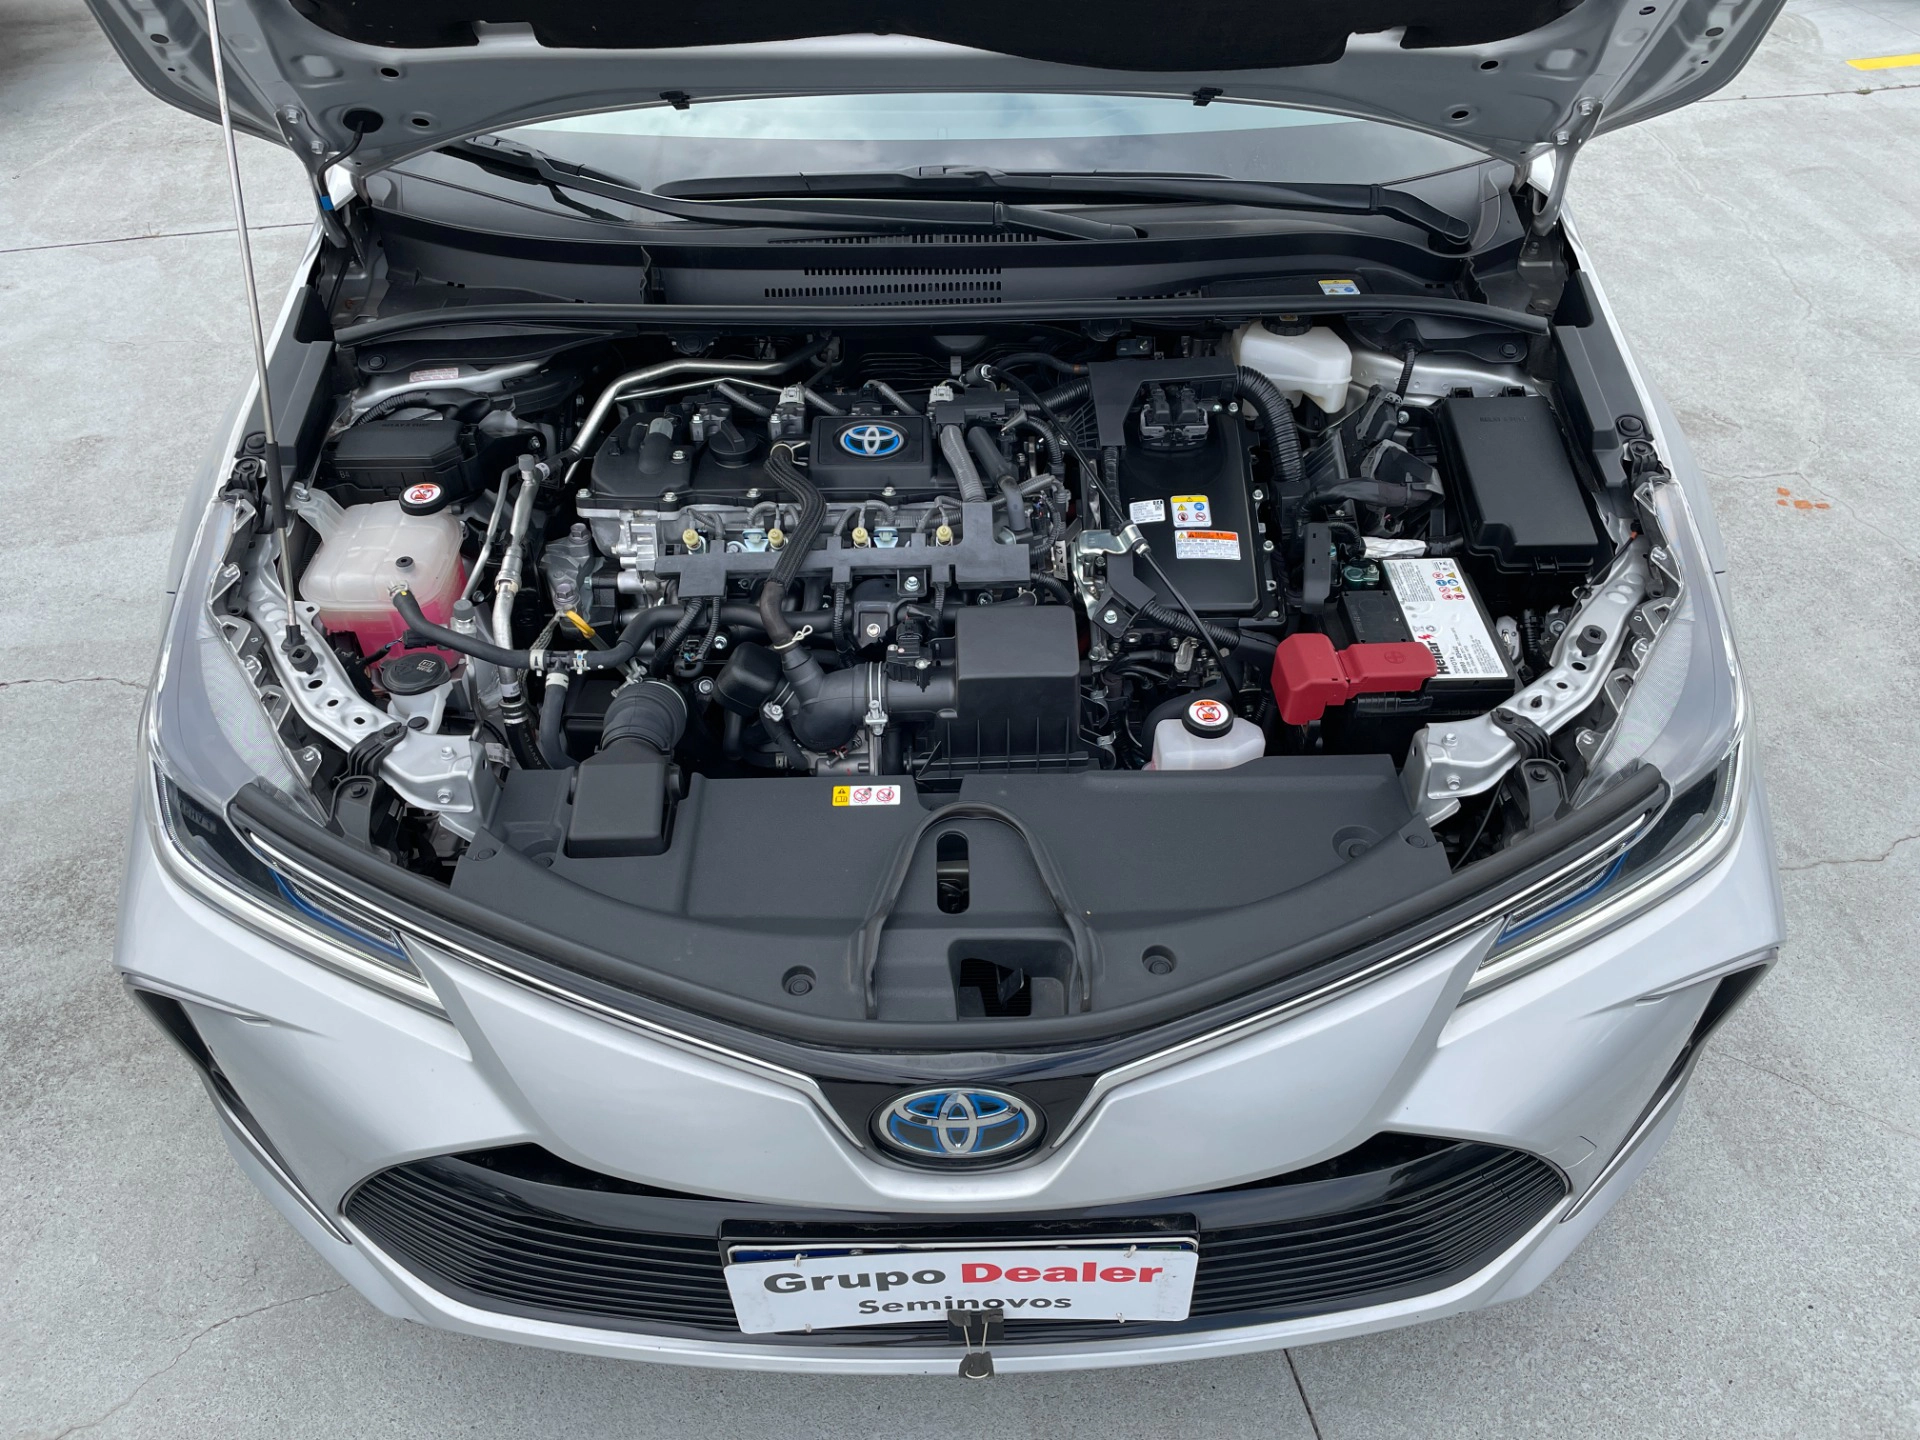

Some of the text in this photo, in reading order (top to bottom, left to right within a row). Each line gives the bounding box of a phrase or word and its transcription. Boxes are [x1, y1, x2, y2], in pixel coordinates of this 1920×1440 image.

[764, 1262, 1164, 1294] Grupo Dealer
[859, 1295, 1072, 1314] Seminovos
